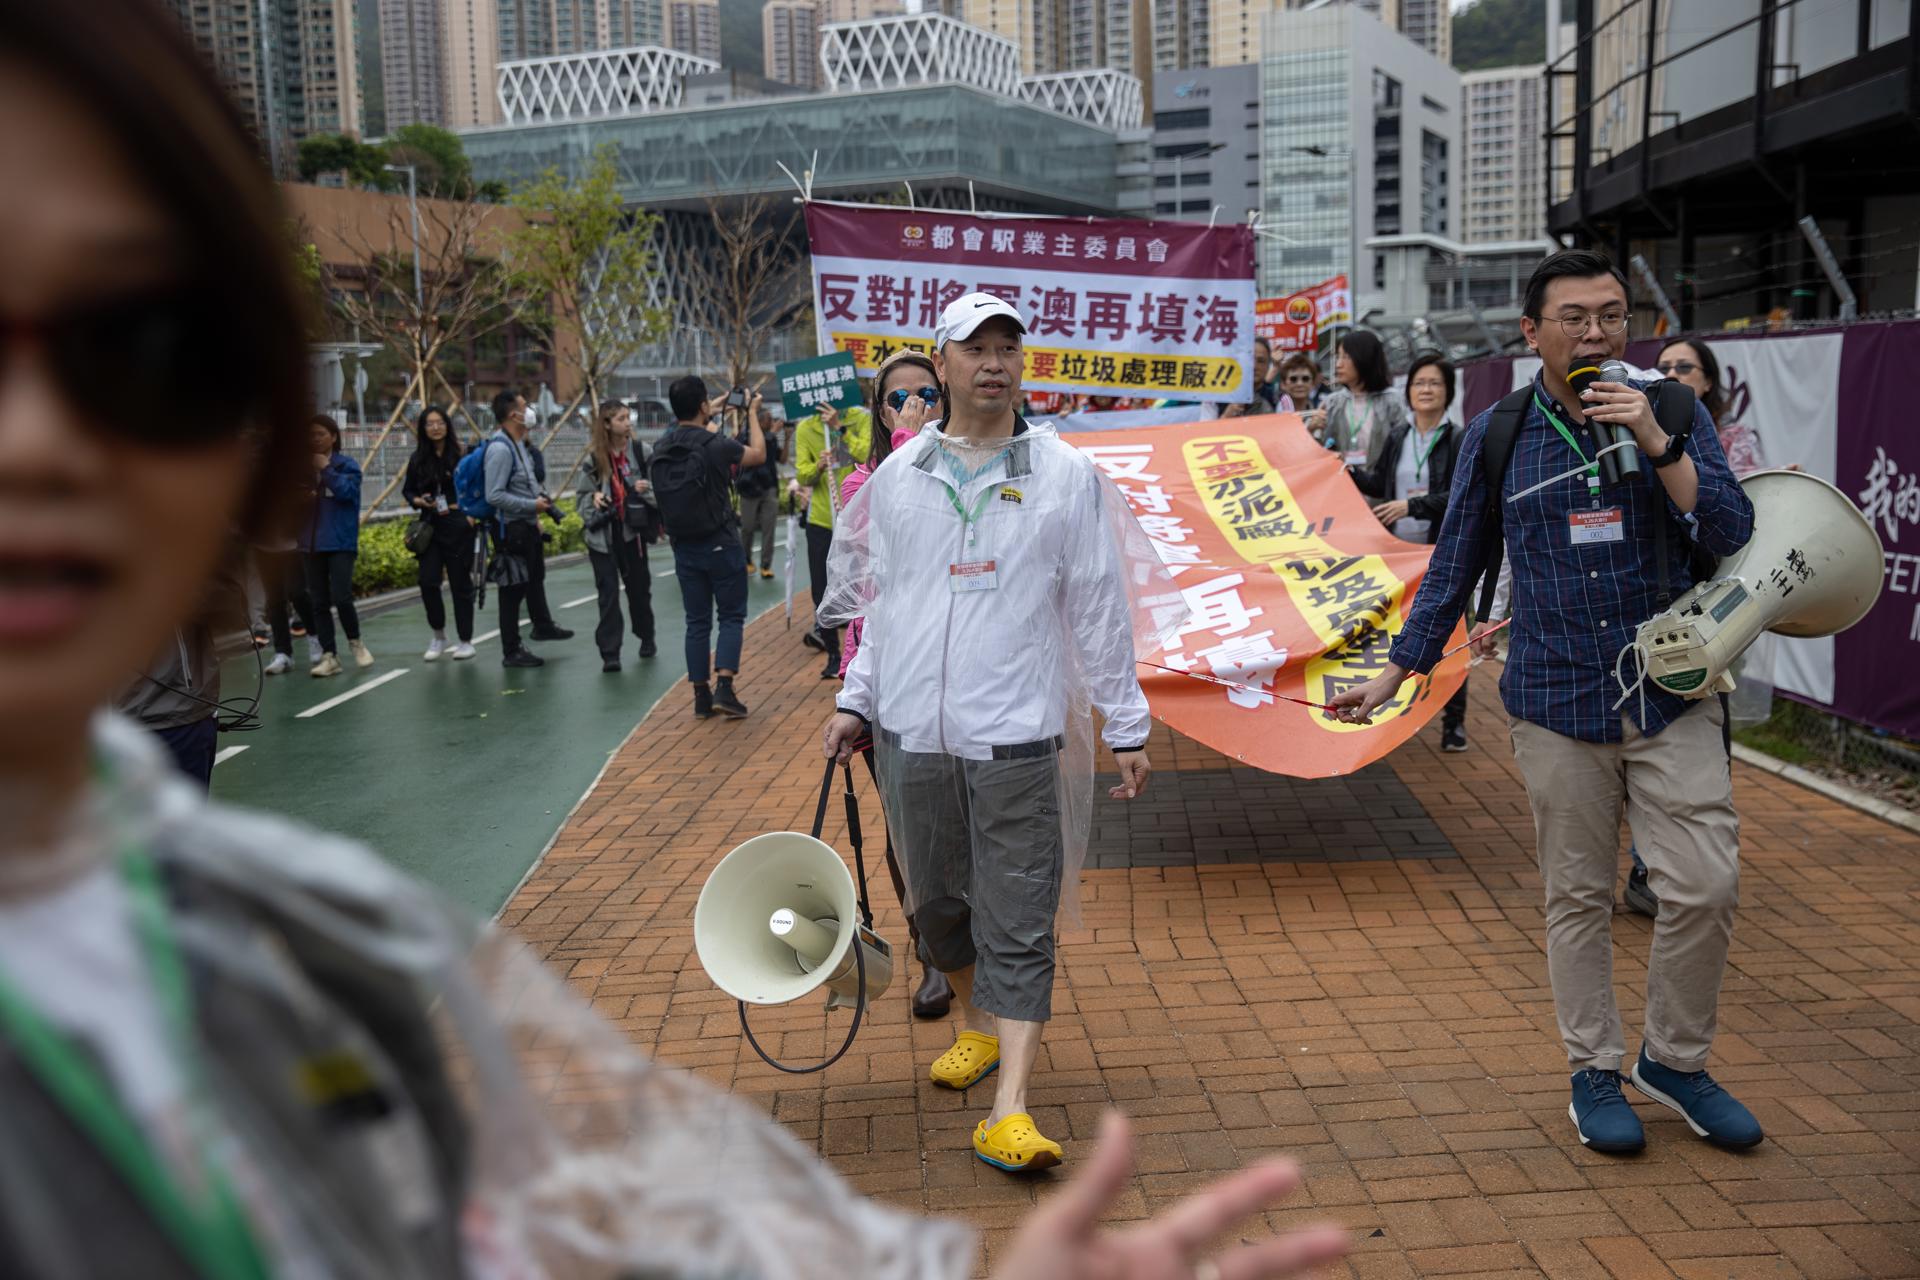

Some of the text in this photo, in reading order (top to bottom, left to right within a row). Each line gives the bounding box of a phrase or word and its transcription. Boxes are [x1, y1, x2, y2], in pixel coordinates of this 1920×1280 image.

[782, 365, 855, 393] 反對將軍澳
[799, 385, 844, 407] 再填海
